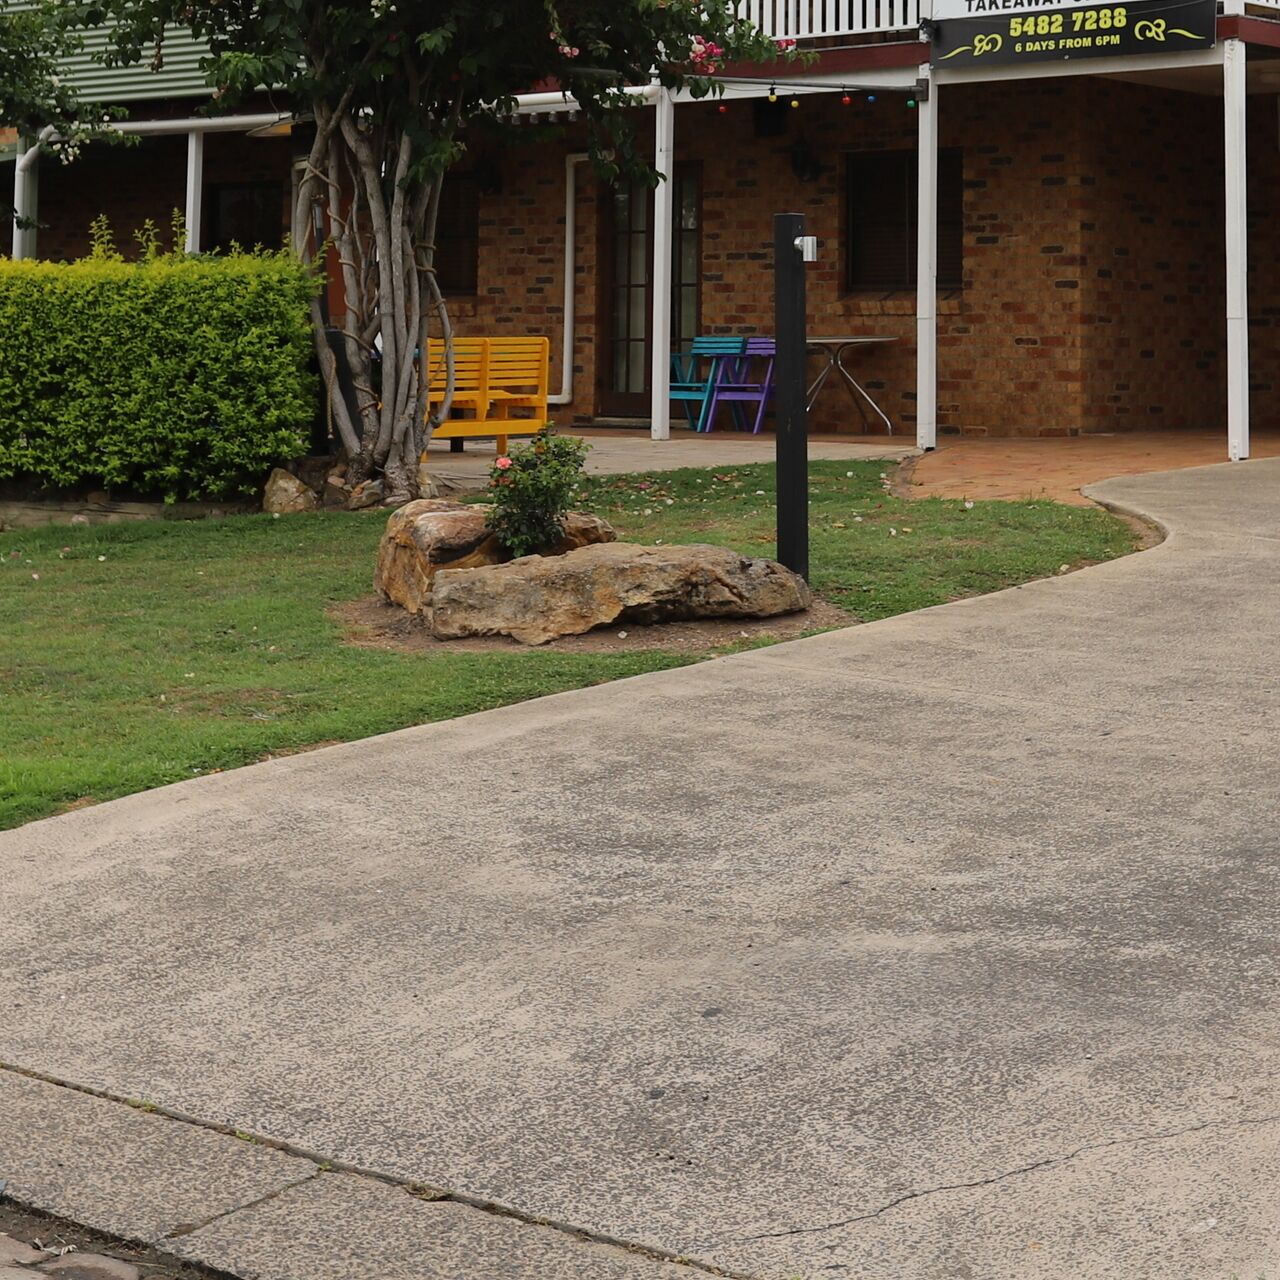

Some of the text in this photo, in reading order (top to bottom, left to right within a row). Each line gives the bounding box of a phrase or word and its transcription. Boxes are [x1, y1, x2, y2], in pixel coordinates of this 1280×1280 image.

[1009, 7, 1128, 38] 5482 7288
[1015, 35, 1121, 53] 6 DAYS FROM 6PM
